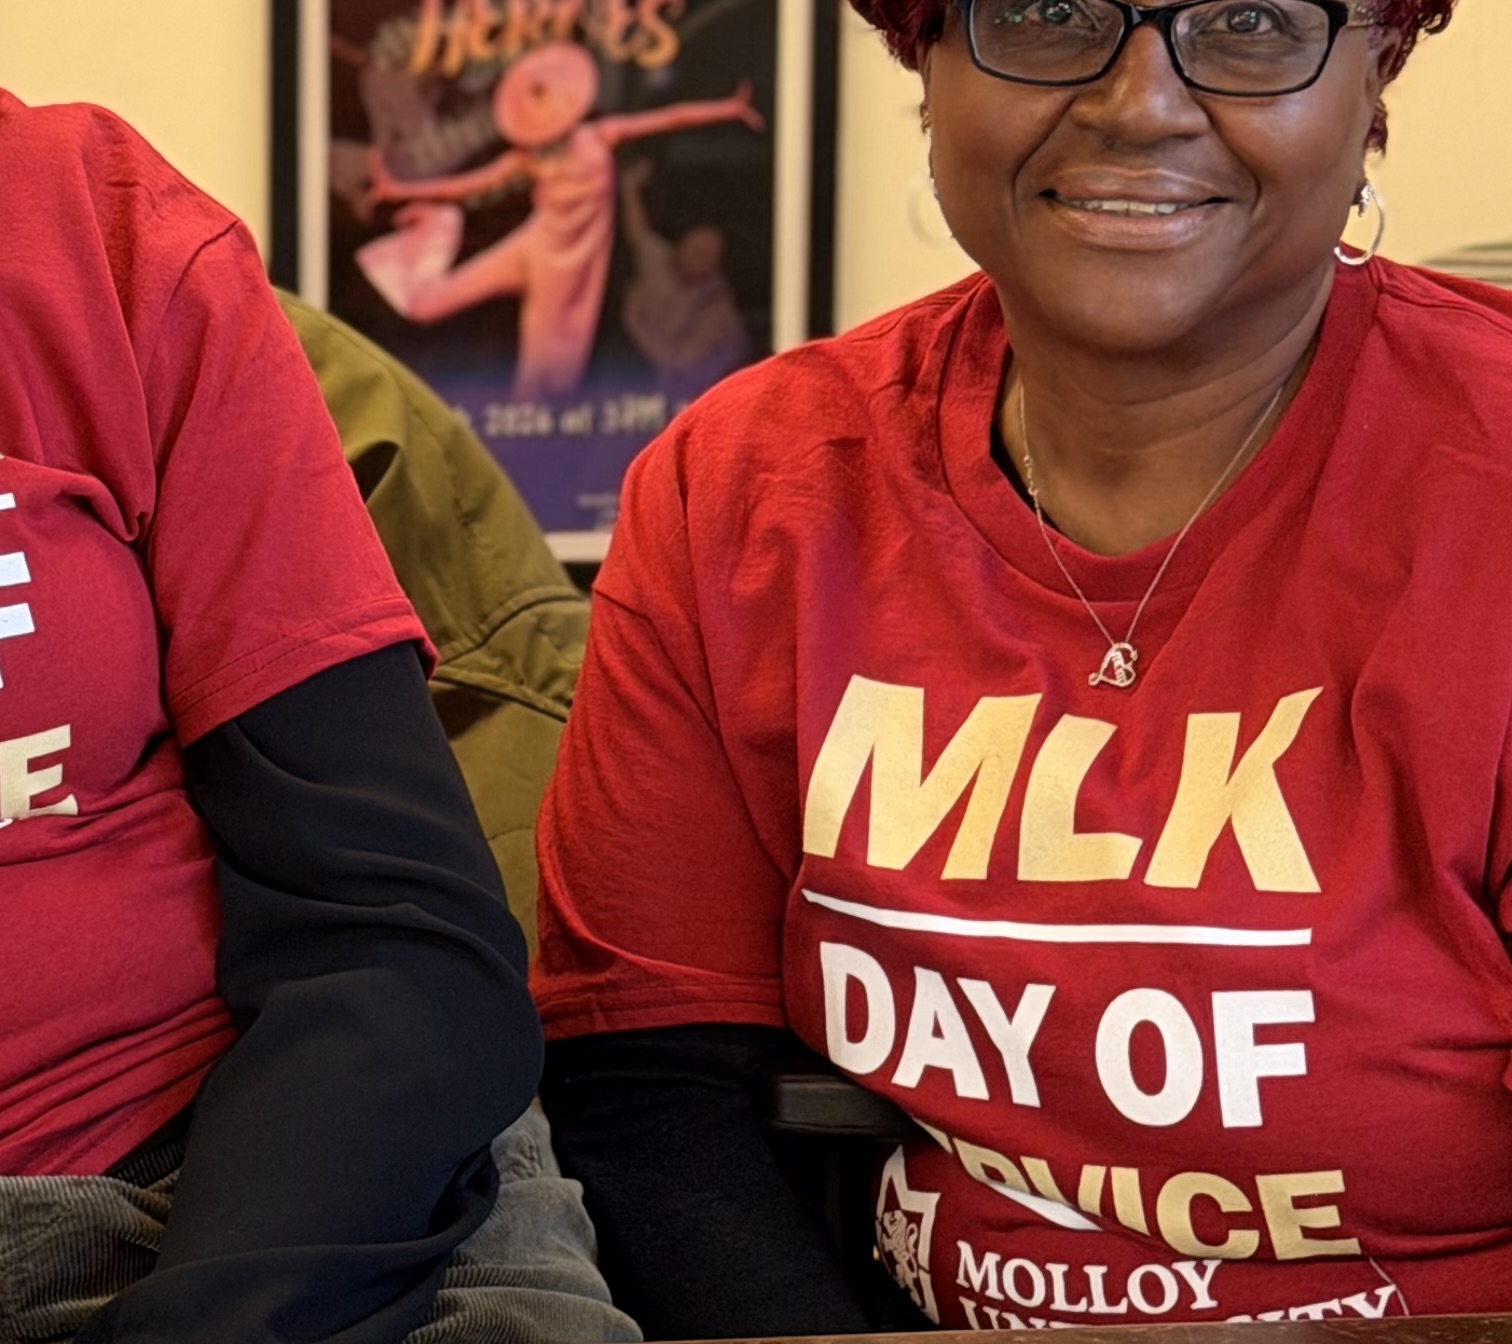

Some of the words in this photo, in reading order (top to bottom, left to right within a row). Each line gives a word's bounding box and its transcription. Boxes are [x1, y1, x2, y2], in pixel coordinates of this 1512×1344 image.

[802, 674, 1324, 893] MLK
[819, 941, 1057, 1109] DAY
[1095, 987, 1316, 1129] OF
[955, 1240, 1222, 1315] MOLLOY
